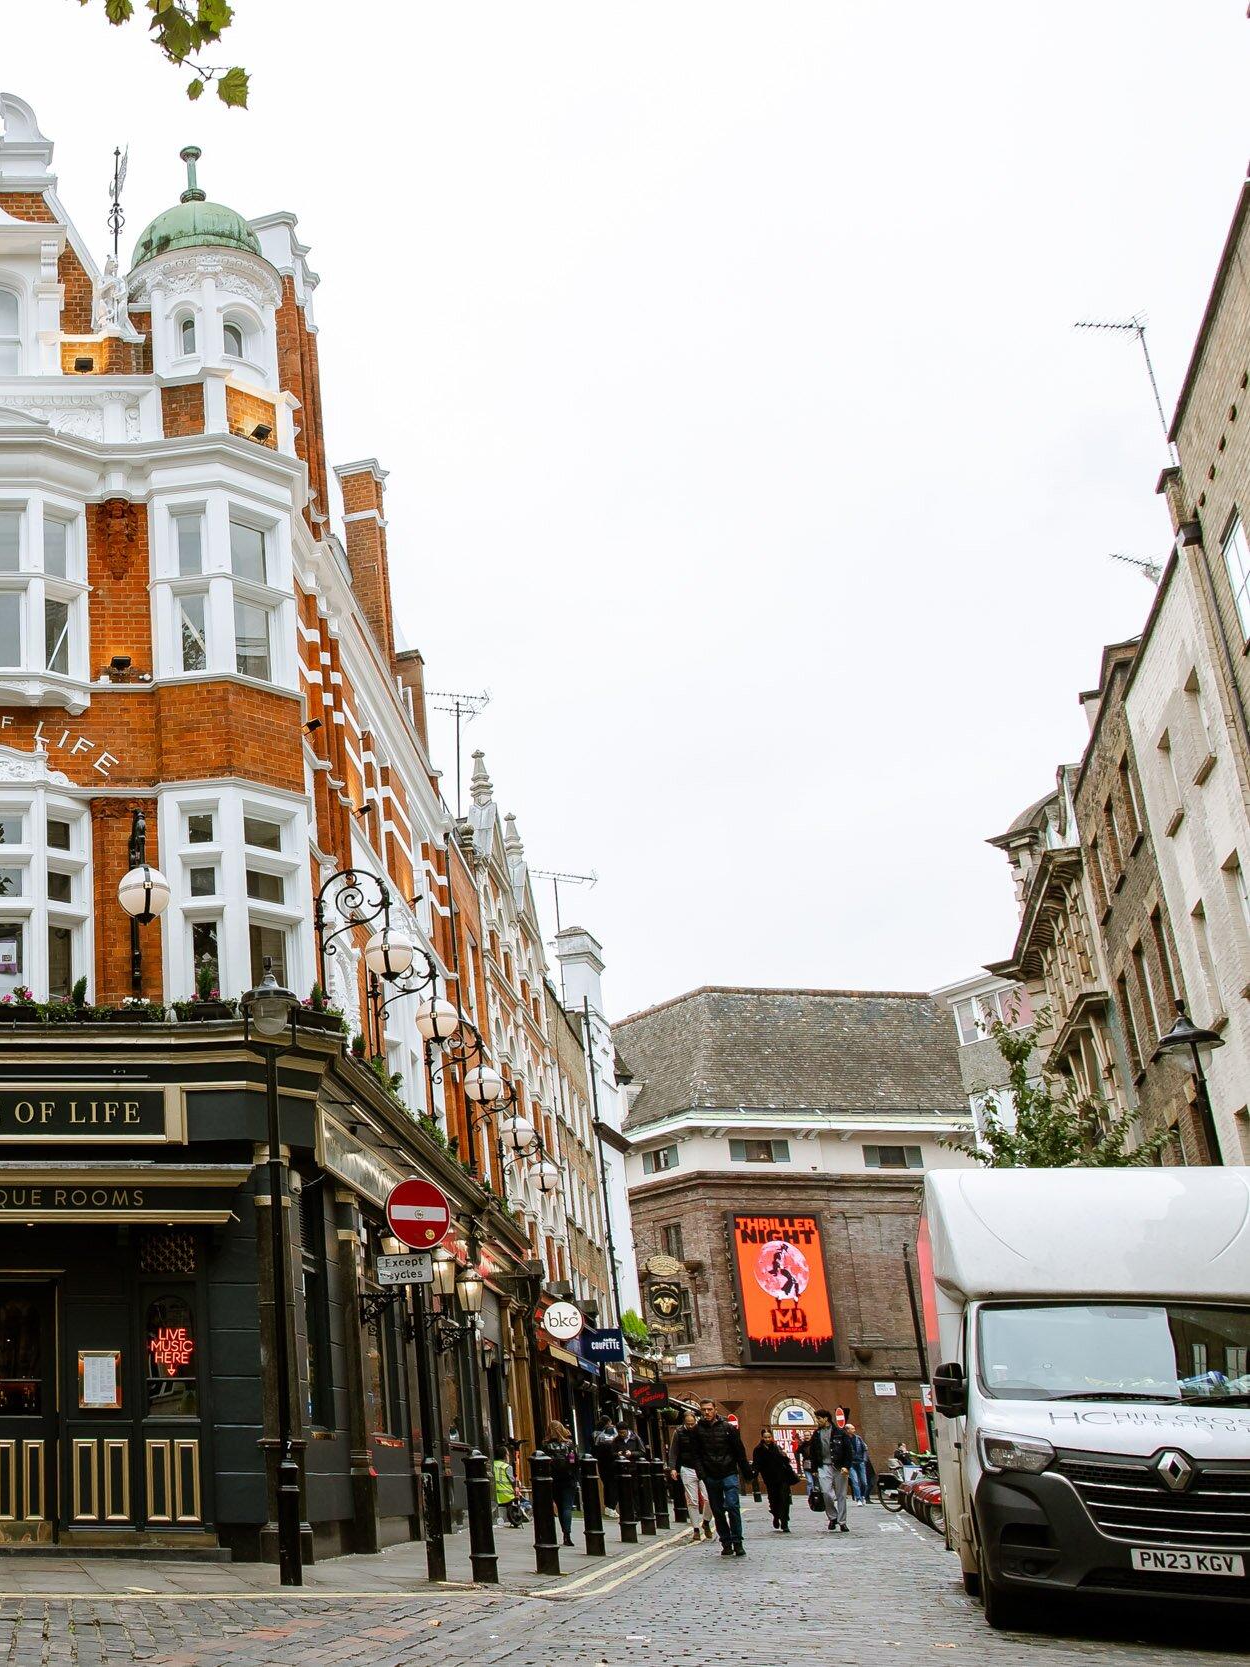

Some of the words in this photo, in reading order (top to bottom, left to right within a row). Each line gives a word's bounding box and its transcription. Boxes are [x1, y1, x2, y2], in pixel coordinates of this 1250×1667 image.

[34, 721, 120, 776] LIFE
[14, 1101, 56, 1124] OF
[69, 1101, 141, 1124] LIFE
[55, 1189, 144, 1206] ROOMS
[736, 1217, 816, 1231] THRILLER
[741, 1229, 814, 1245] NIGHT
[385, 1256, 424, 1268] Except
[775, 1309, 803, 1328] MJ
[159, 1328, 186, 1340] LIVE
[151, 1340, 193, 1352] MUSIC
[591, 1341, 621, 1350] COUPETTE
[155, 1351, 189, 1364] HERE
[1049, 1412, 1112, 1425] HC
[1113, 1412, 1168, 1421] HILL
[1139, 1551, 1192, 1569] PN23
[1196, 1554, 1234, 1573] KGV
